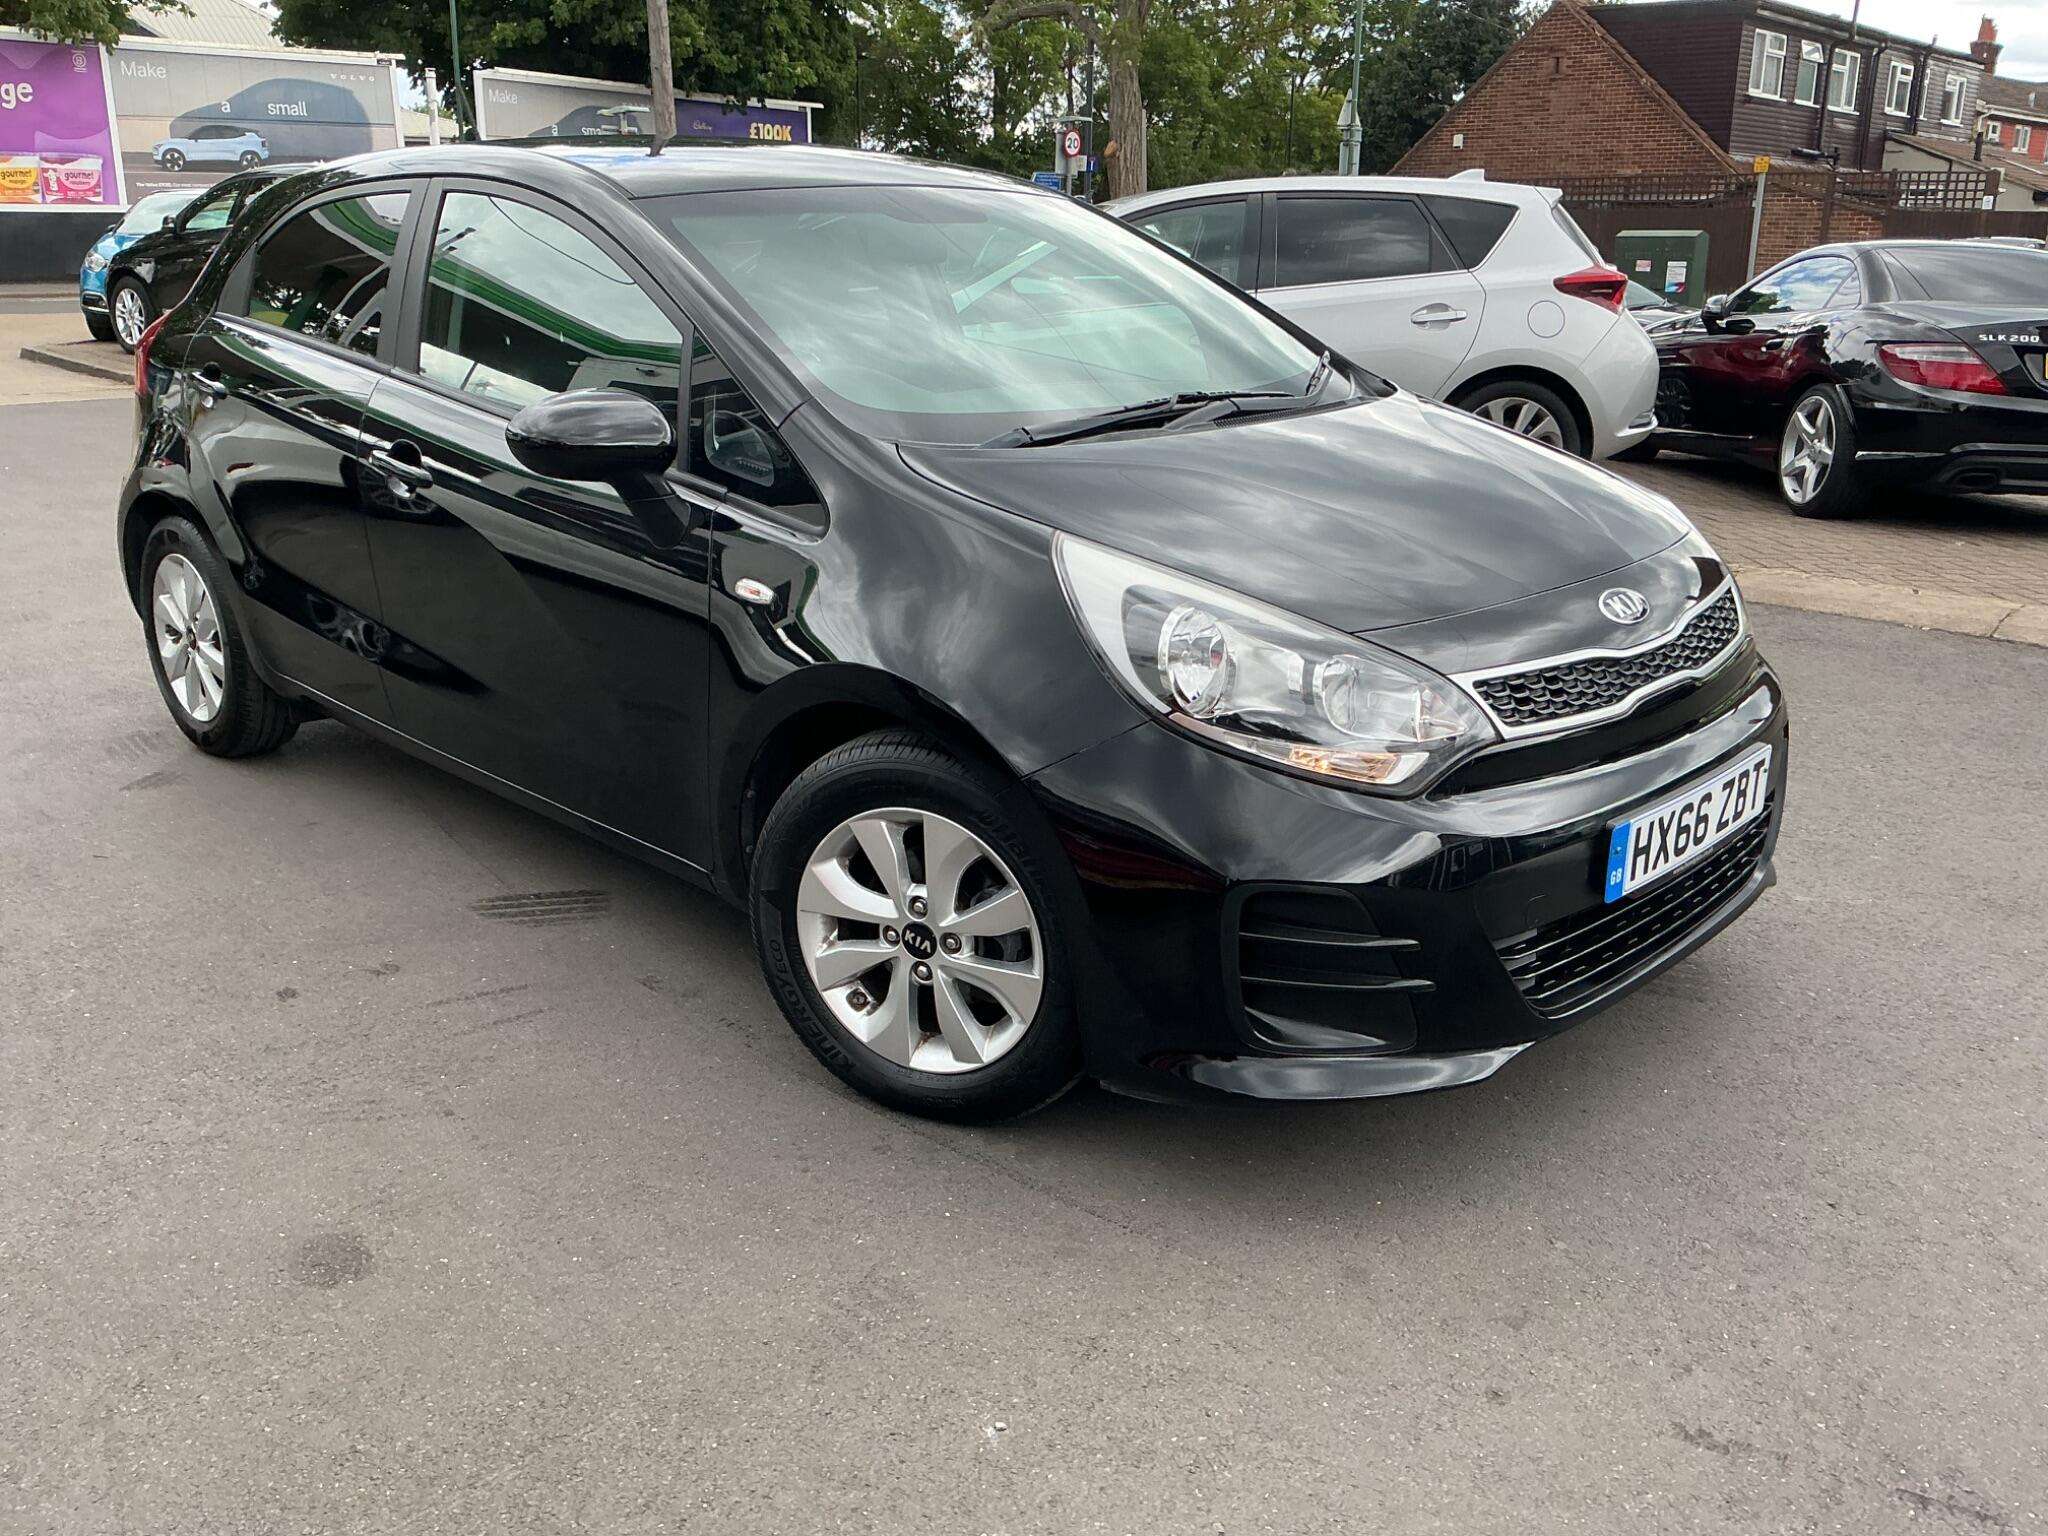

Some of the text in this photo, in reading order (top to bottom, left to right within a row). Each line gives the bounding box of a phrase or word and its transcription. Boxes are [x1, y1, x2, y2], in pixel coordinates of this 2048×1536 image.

[120, 60, 168, 79] Make
[330, 73, 375, 82] VOLVO
[0, 82, 34, 110] ge
[488, 88, 518, 104] Make
[220, 101, 308, 117] a small
[551, 124, 559, 135] a
[749, 122, 792, 142] £100K
[1066, 137, 1080, 150] 20
[0, 168, 32, 180] gourmet
[64, 171, 94, 181] gourmet
[2009, 334, 2040, 343] 200
[1629, 757, 1766, 882] HX66 ZBT
[1610, 868, 1622, 886] GB
[905, 929, 931, 954] KIA
